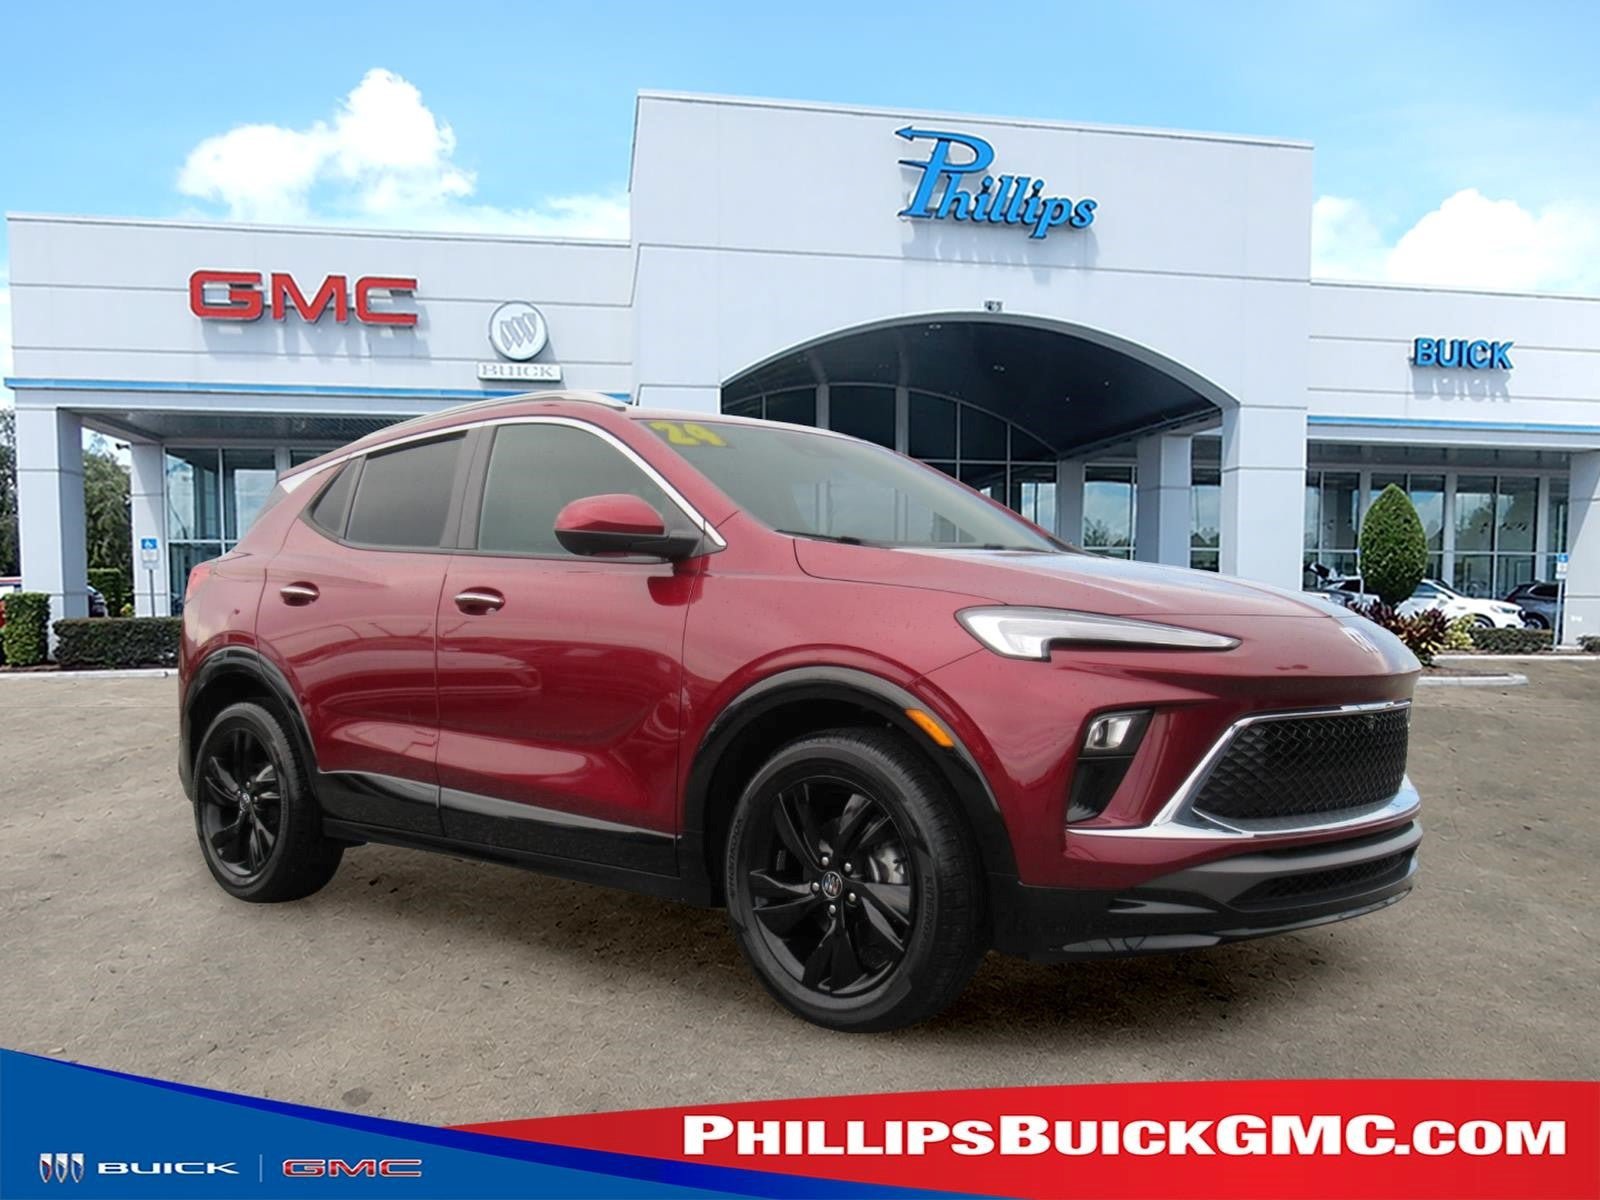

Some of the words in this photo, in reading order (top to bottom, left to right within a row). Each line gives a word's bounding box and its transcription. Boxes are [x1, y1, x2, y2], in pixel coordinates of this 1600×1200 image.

[895, 126, 1098, 239] Phillips
[190, 270, 417, 327] GMC
[1414, 337, 1514, 369] BUICK
[482, 364, 553, 377] BUICK
[649, 421, 728, 447] 24
